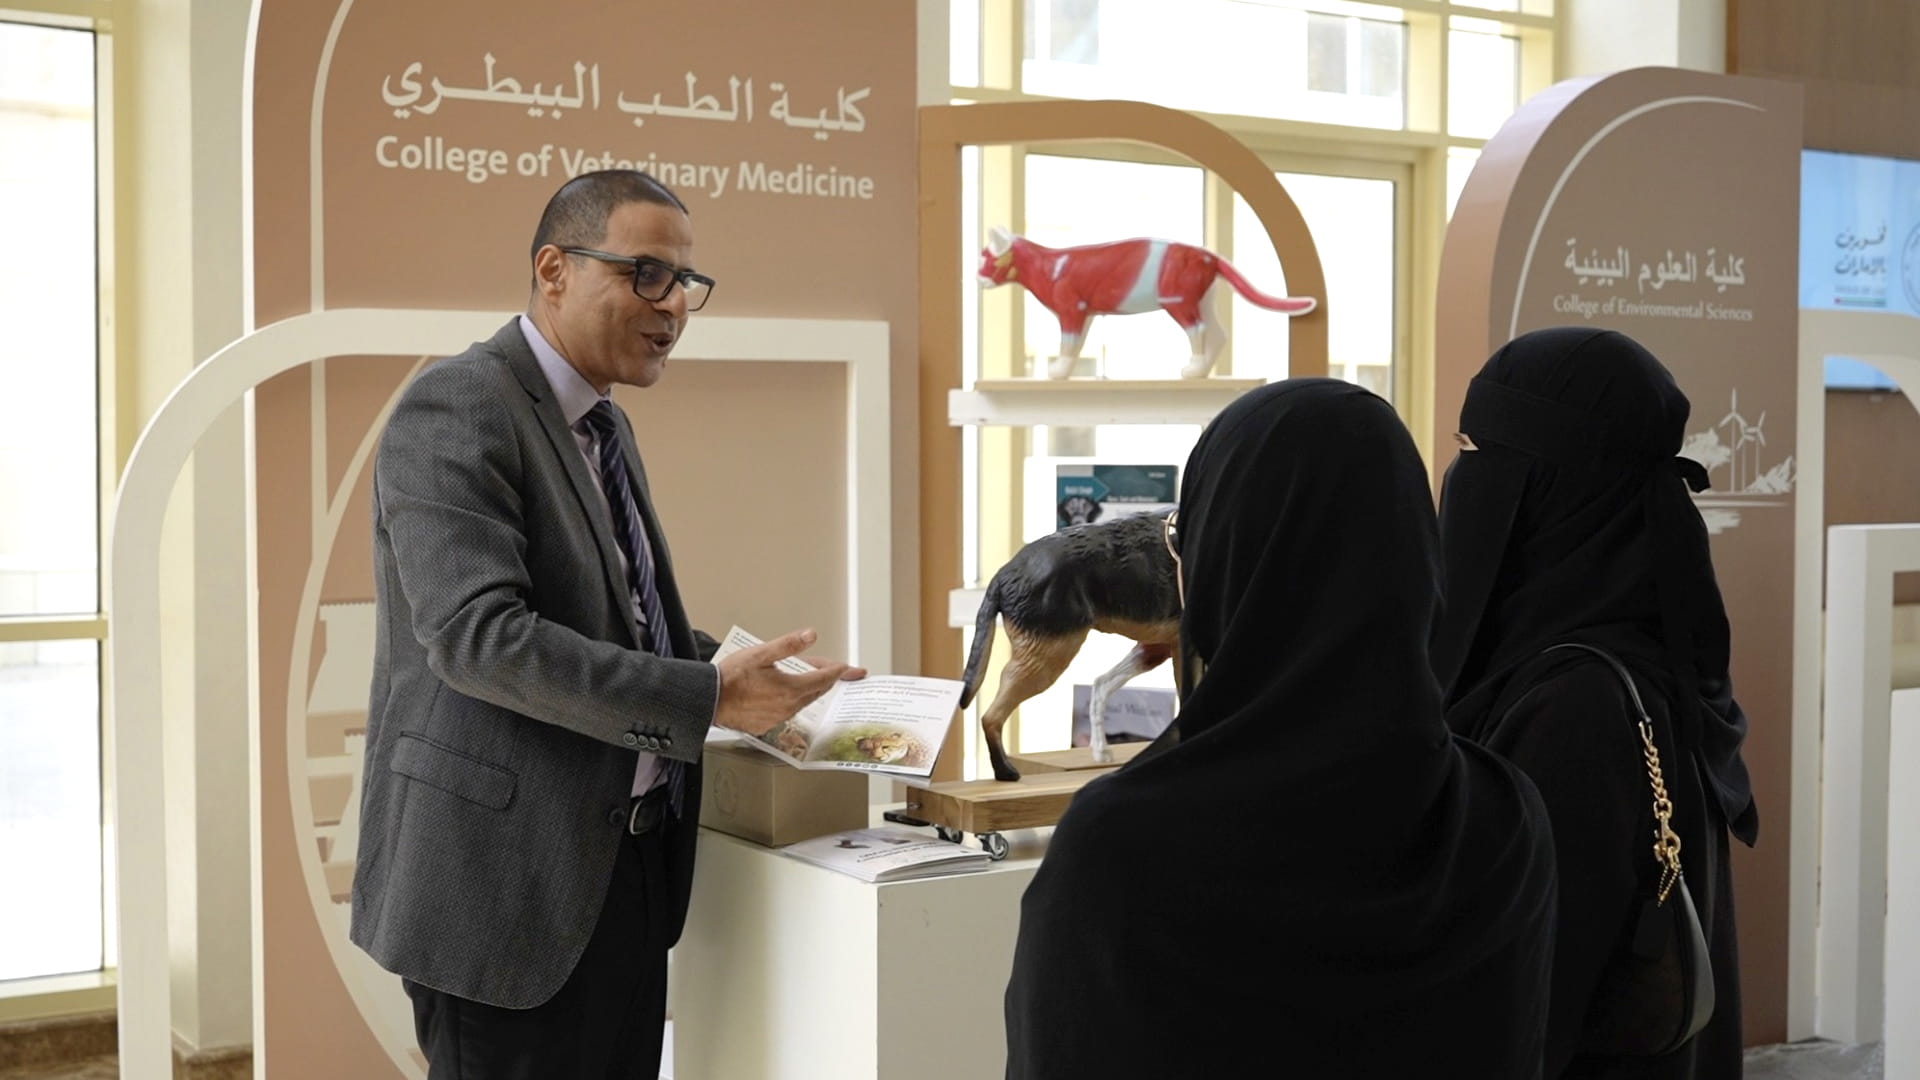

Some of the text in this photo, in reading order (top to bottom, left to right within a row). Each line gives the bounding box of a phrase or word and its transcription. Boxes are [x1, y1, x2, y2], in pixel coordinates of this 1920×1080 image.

[382, 52, 871, 141] كلية الطب البيطري
[375, 135, 508, 184] College
[516, 144, 553, 177] of
[737, 161, 874, 199] Medicine
[1637, 250, 1698, 294] العلوم
[1705, 247, 1745, 293] كلية
[1553, 295, 1753, 322] College of Environmental Sciences
